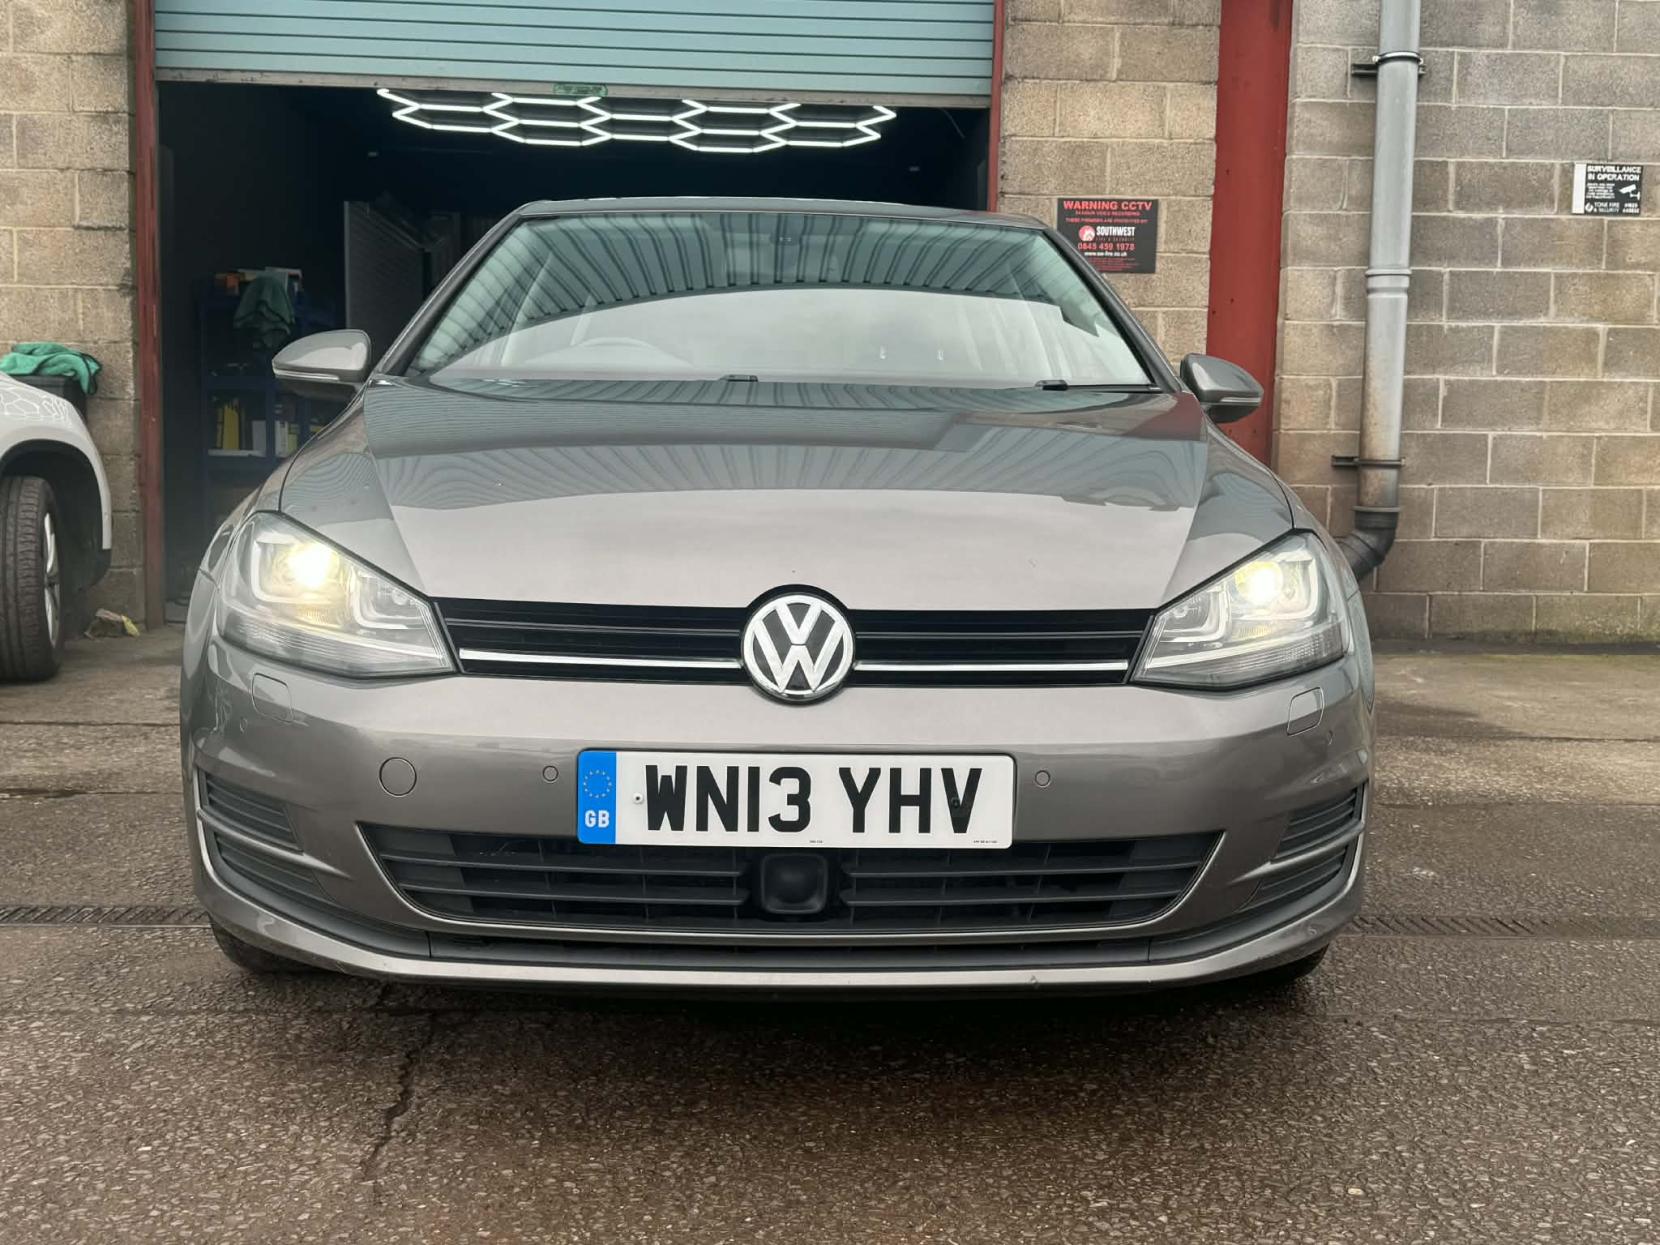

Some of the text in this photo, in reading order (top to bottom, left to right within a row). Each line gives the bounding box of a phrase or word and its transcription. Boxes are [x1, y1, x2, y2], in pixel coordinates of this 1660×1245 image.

[1587, 165, 1642, 173] SURVEILLANCE
[1597, 173, 1640, 181] OPERATION
[1063, 200, 1153, 210] WARNING CCTV
[1096, 226, 1135, 236] SOUTHWEST
[1078, 242, 1097, 250] 0845
[1099, 242, 1114, 250] 459
[645, 764, 983, 834] WN13 YHV
[584, 809, 610, 829] GB
